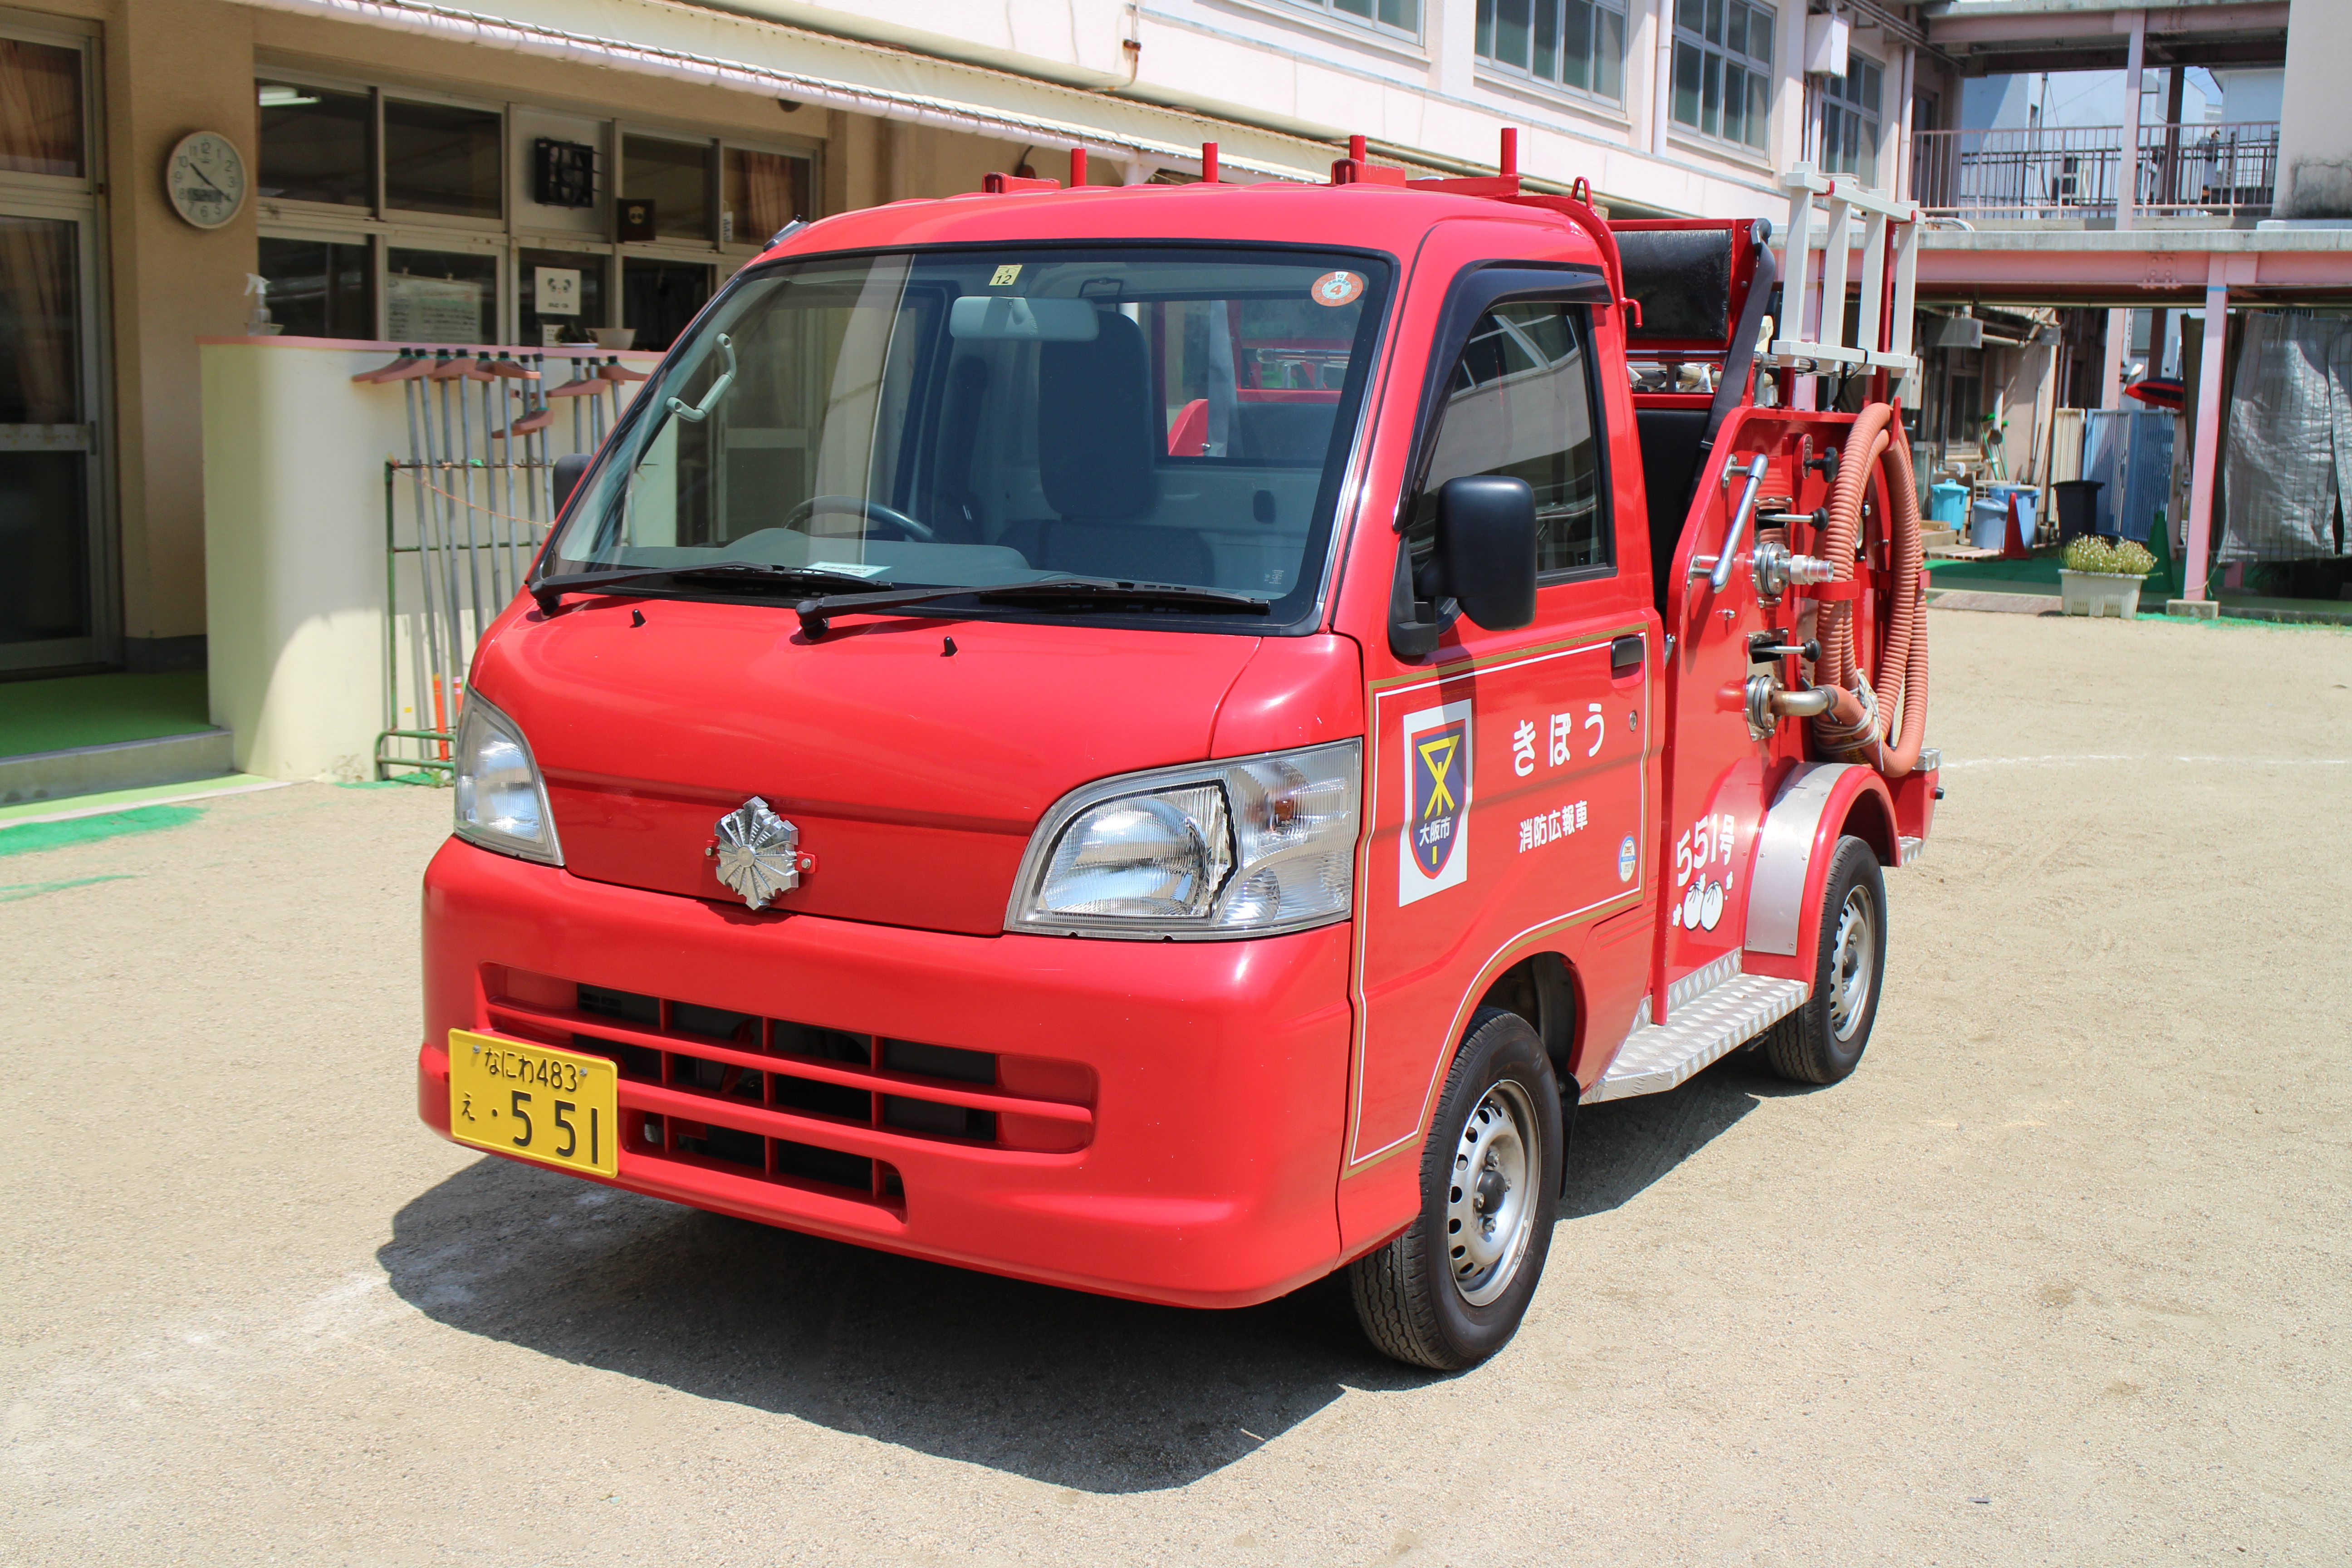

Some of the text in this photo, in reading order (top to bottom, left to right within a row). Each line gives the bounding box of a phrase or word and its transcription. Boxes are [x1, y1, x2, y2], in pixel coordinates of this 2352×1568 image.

[996, 275, 1012, 284] 12
[1330, 284, 1343, 295] 4
[1512, 703, 1605, 777] きぼう
[1419, 816, 1451, 847] 大阪市
[1519, 799, 1588, 854] 消防広報車
[1676, 813, 1735, 887] 551号
[461, 1090, 475, 1122] え
